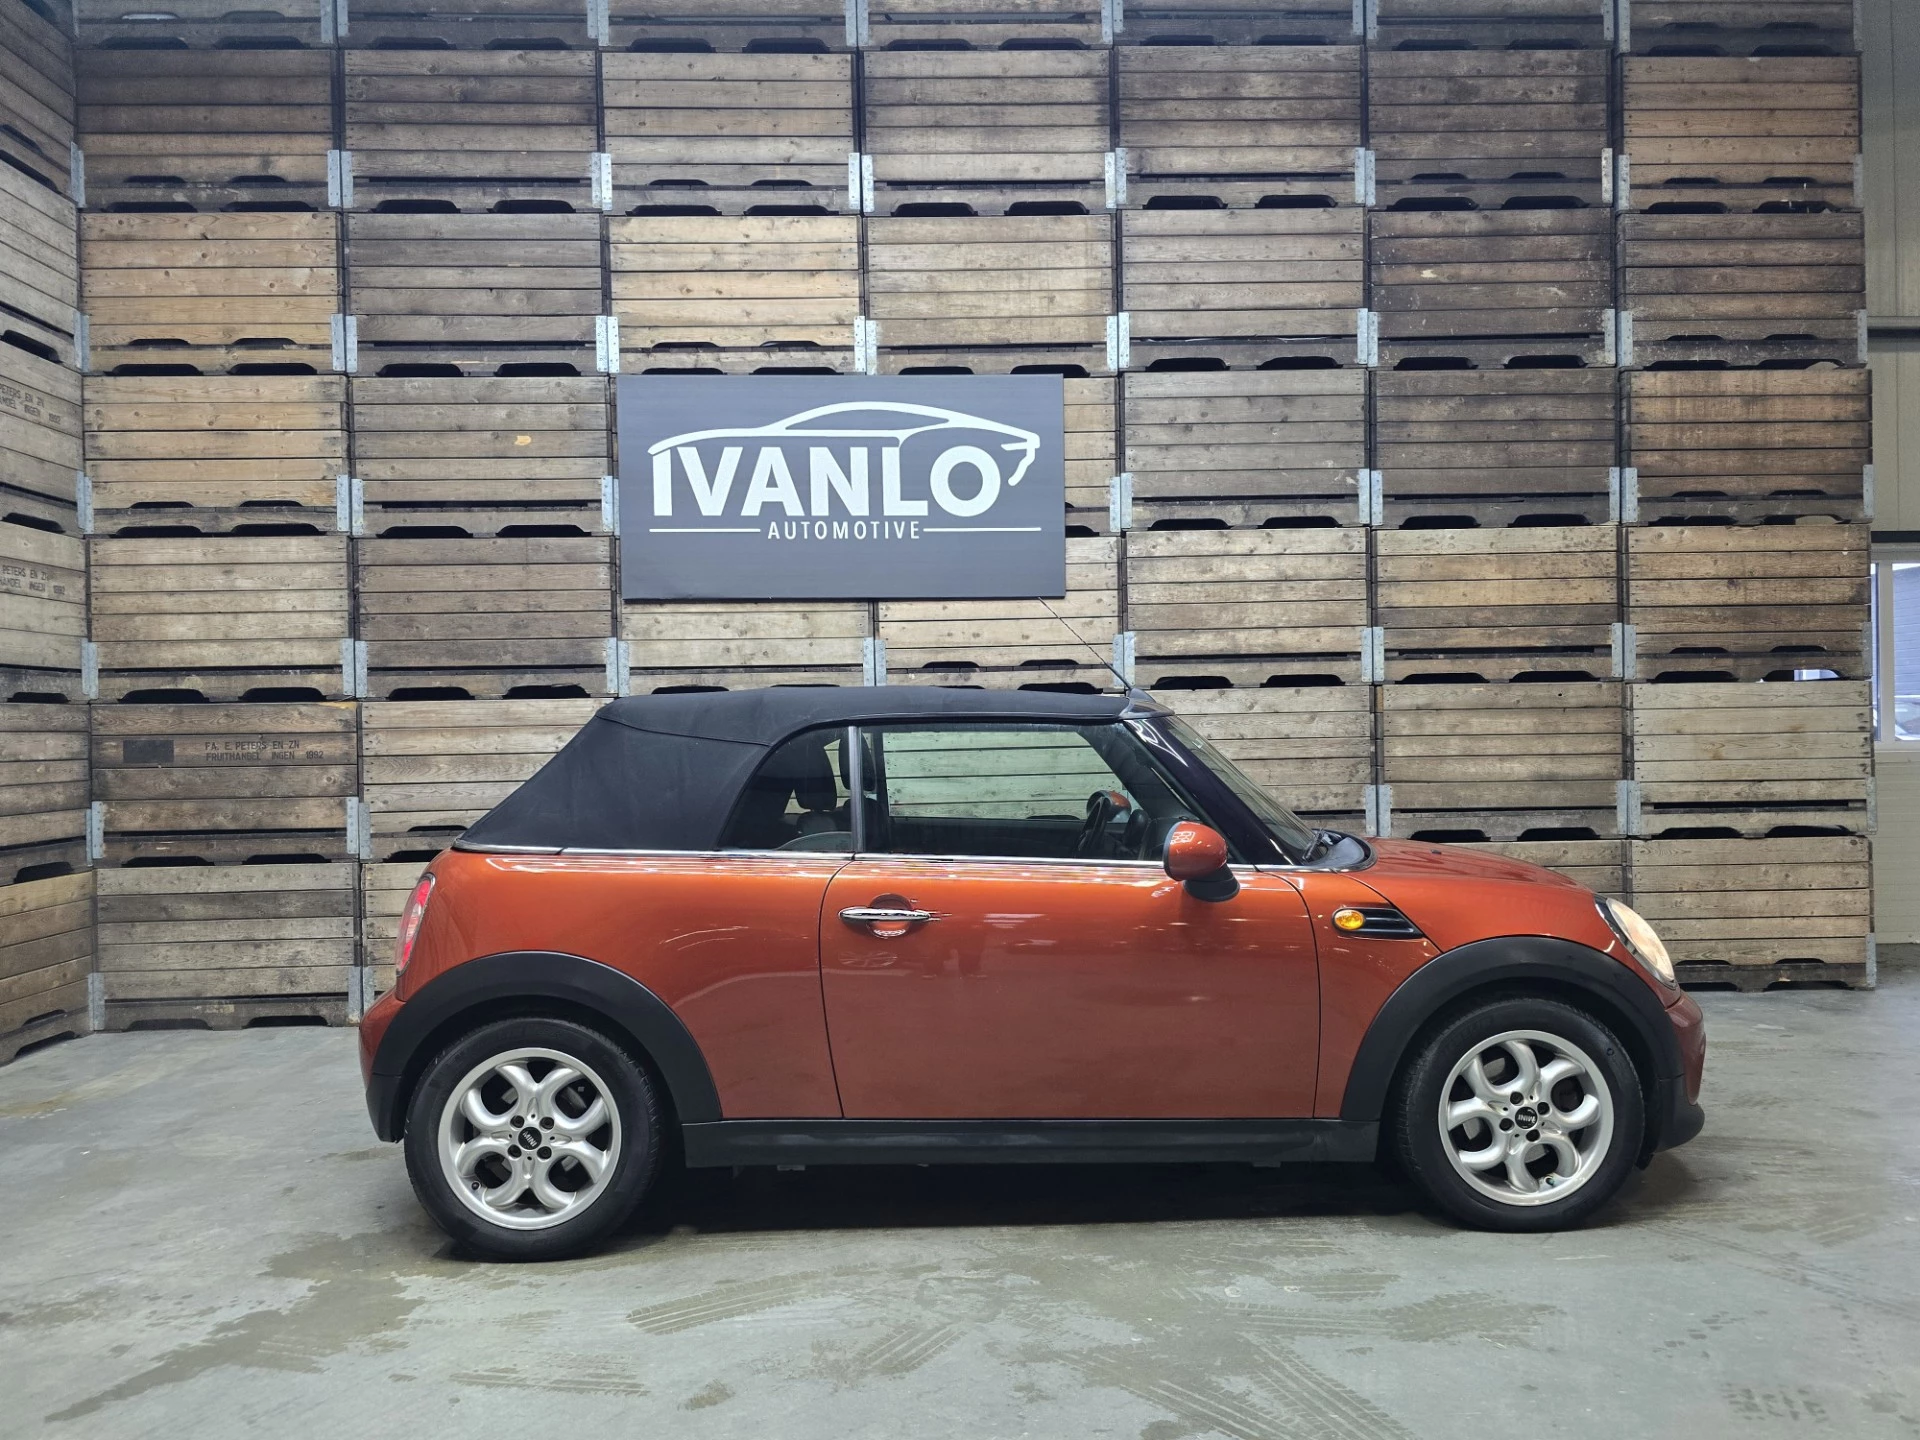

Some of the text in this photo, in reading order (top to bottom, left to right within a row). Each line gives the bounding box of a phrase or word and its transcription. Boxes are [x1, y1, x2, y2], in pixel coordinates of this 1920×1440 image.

[652, 445, 1001, 517] IVANLO
[767, 520, 921, 541] AUTOMOTIVE
[235, 741, 267, 751] PETERS
[271, 751, 295, 760] INGEN
[522, 1131, 538, 1147] MINI
